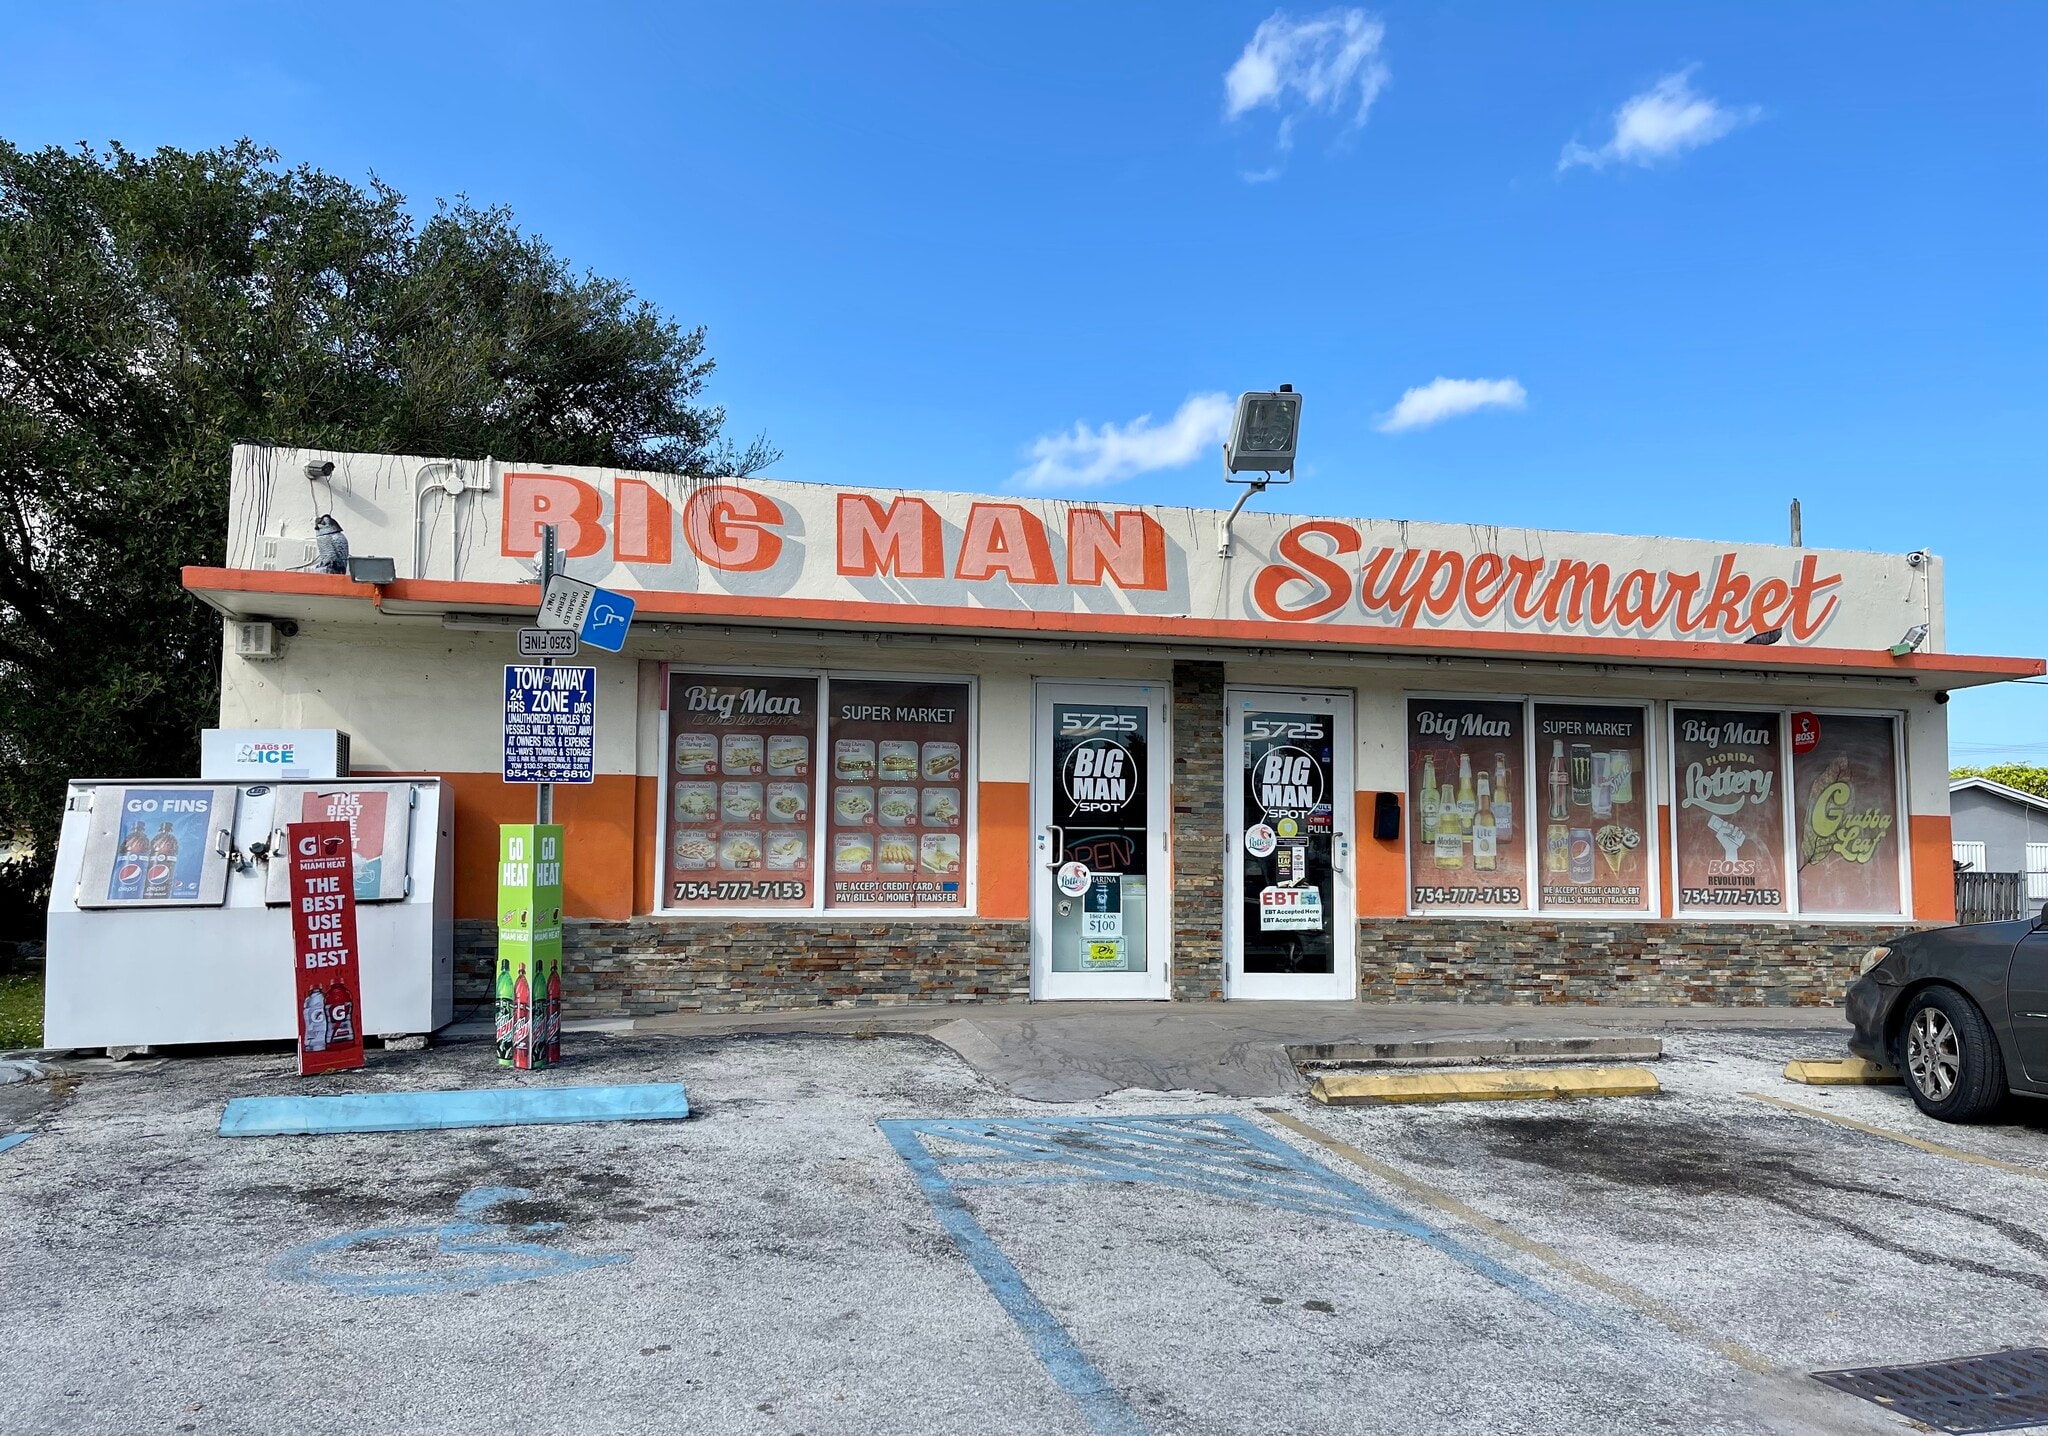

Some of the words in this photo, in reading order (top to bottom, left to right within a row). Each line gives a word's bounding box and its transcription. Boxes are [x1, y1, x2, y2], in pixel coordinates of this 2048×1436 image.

[500, 472, 784, 572] BIG
[836, 493, 1167, 591] MAN
[1254, 520, 1843, 637] Supermarket
[546, 593, 556, 611] ONLY
[555, 592, 568, 618] PERMIT
[563, 592, 579, 625] DISABLED
[577, 590, 590, 621] PARKING
[525, 636, 547, 649] FINE
[550, 636, 571, 650] $250
[514, 668, 545, 689] TOW
[551, 669, 586, 690] AWAY
[510, 689, 523, 700] 24
[532, 690, 569, 712] ZONE
[580, 691, 587, 702] 7
[685, 686, 735, 719] Big
[740, 689, 801, 715] Man
[507, 701, 525, 712] HRS
[574, 702, 592, 714] DAYS
[842, 706, 891, 720] SUPER
[896, 707, 955, 723] MARKET
[508, 714, 551, 724] UNAUTHORIZED
[553, 714, 580, 725] VEHICLES
[582, 715, 590, 725] OR
[1062, 713, 1138, 731] 5725
[1416, 711, 1458, 741] Big
[1460, 714, 1511, 736] Man
[506, 724, 531, 735] VESSELS
[532, 725, 545, 735] WILL
[547, 725, 555, 735] BE
[557, 725, 576, 735] TOWED
[578, 726, 592, 736] AWAY
[1252, 720, 1324, 739] 5725
[1543, 721, 1582, 734] SUPER
[1585, 722, 1632, 736] MARKET
[1682, 720, 1720, 749] Big
[1723, 722, 1770, 745] Man
[1795, 731, 1815, 742] BOSS
[508, 736, 515, 746] AT
[517, 736, 541, 746] OWNERS
[543, 737, 556, 746] RISK
[558, 737, 562, 747] &
[564, 737, 590, 747] EXPENSE
[258, 750, 294, 763] ICE
[506, 748, 534, 756] ALL-WAYS
[535, 748, 558, 756] TOWING
[565, 748, 592, 756] STORAGE
[1706, 752, 1755, 767] FLORIDA
[1073, 748, 1123, 778] BIG
[1263, 756, 1310, 785] BIG
[1073, 777, 1126, 800] MAN
[1262, 785, 1313, 808] MAN
[1682, 762, 1773, 815] Lottery
[127, 799, 158, 813] GO
[162, 799, 208, 813] FINS
[332, 794, 360, 805] THE
[1079, 802, 1121, 813] SPOT
[327, 805, 363, 816] BEST
[1268, 809, 1309, 819] SPOT
[1811, 783, 1893, 837] Grabba
[1307, 825, 1331, 833] PULL
[1476, 829, 1492, 839] Lite
[299, 836, 317, 856] G
[508, 837, 524, 861] GO
[541, 837, 556, 860] GO
[1438, 836, 1460, 845] Modelo
[1833, 828, 1886, 864] Leaf
[300, 861, 325, 870] MIAMI
[326, 860, 346, 869] HEAT
[1708, 860, 1755, 875] BOSS
[503, 863, 529, 887] HEAT
[536, 862, 560, 887] HEAT
[1708, 876, 1755, 886] REVOLUTION
[305, 876, 340, 894] THE
[675, 882, 804, 899] 754-777-7153
[835, 882, 848, 891] WE
[850, 882, 880, 891] ACCEPT
[882, 882, 910, 891] CREDIT
[912, 883, 933, 891] CARD
[935, 883, 941, 891] &
[302, 895, 345, 913] BEST
[836, 893, 852, 902] PAY
[853, 893, 875, 902] BILLS
[878, 893, 884, 902] &
[886, 893, 914, 902] MONEY
[916, 893, 957, 902] TRANSFER
[1262, 892, 1298, 906] EBT
[1416, 888, 1520, 903] 754-777-7153
[1683, 889, 1780, 904] 754-777-7153
[308, 913, 342, 931] USE
[308, 932, 343, 950] THE
[305, 950, 349, 969] BEST
[331, 1005, 346, 1021] G
